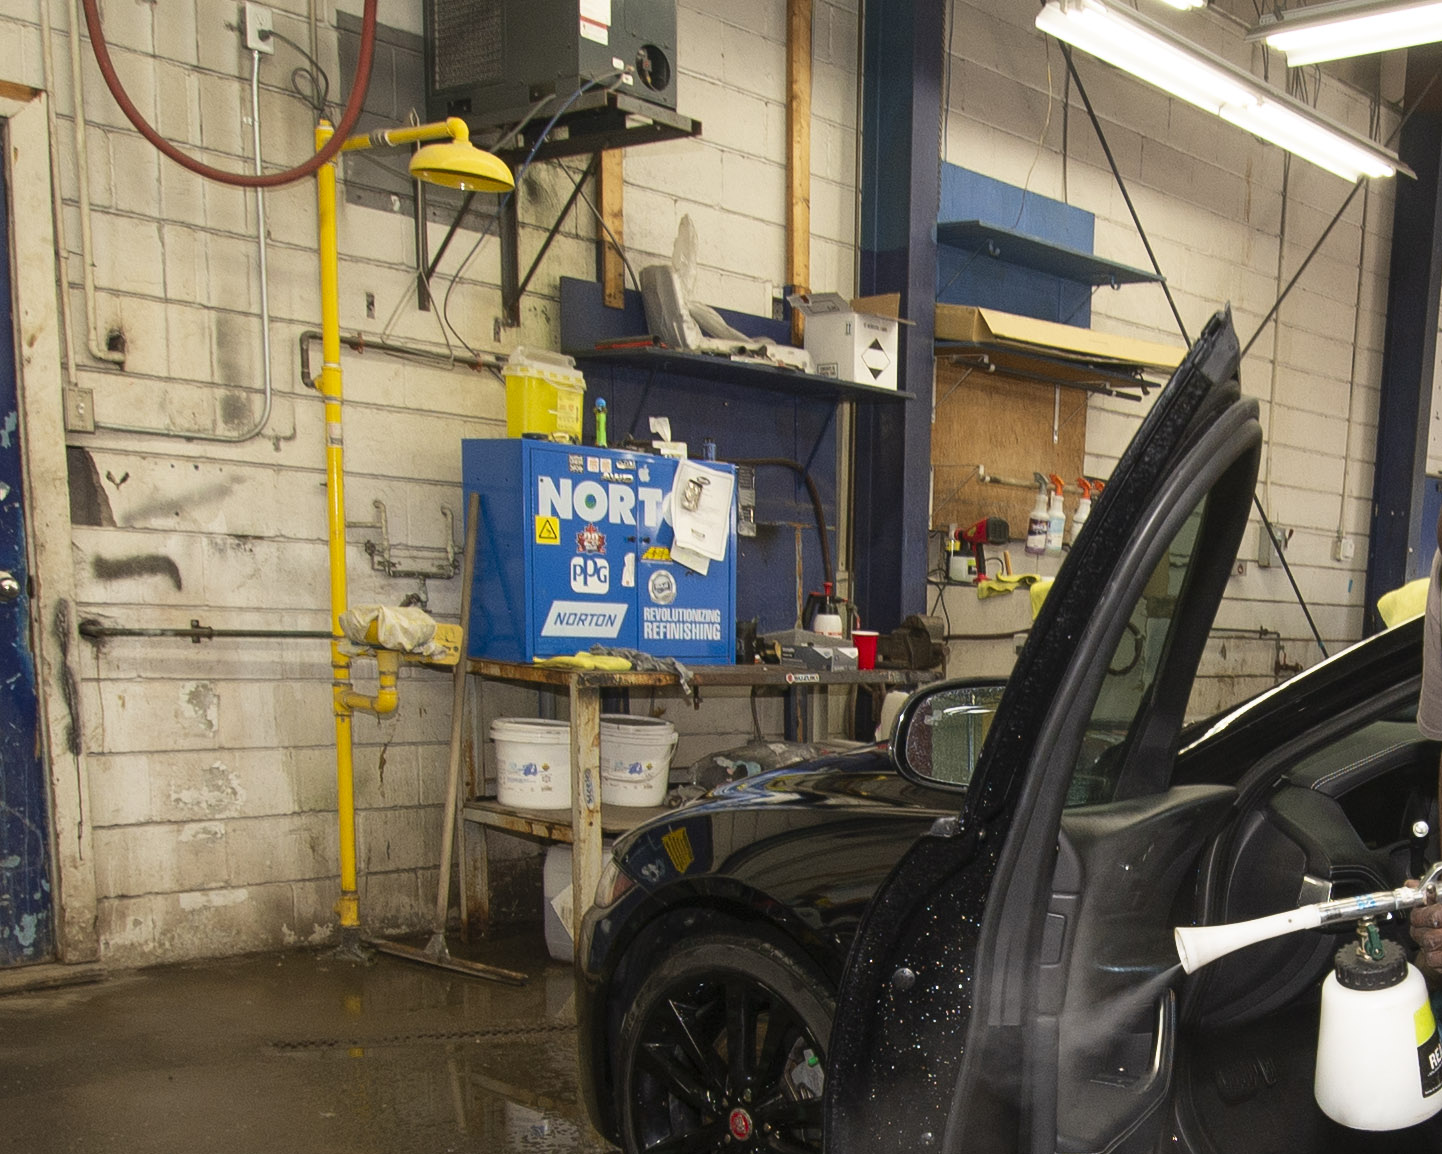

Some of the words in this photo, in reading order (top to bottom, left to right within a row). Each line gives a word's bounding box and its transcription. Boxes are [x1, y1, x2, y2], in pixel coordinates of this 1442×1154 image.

[573, 557, 607, 587] PPG
[553, 612, 617, 628] NORTON
[643, 607, 721, 623] REVOLUTIONIZING
[643, 622, 721, 640] REFINISHING
